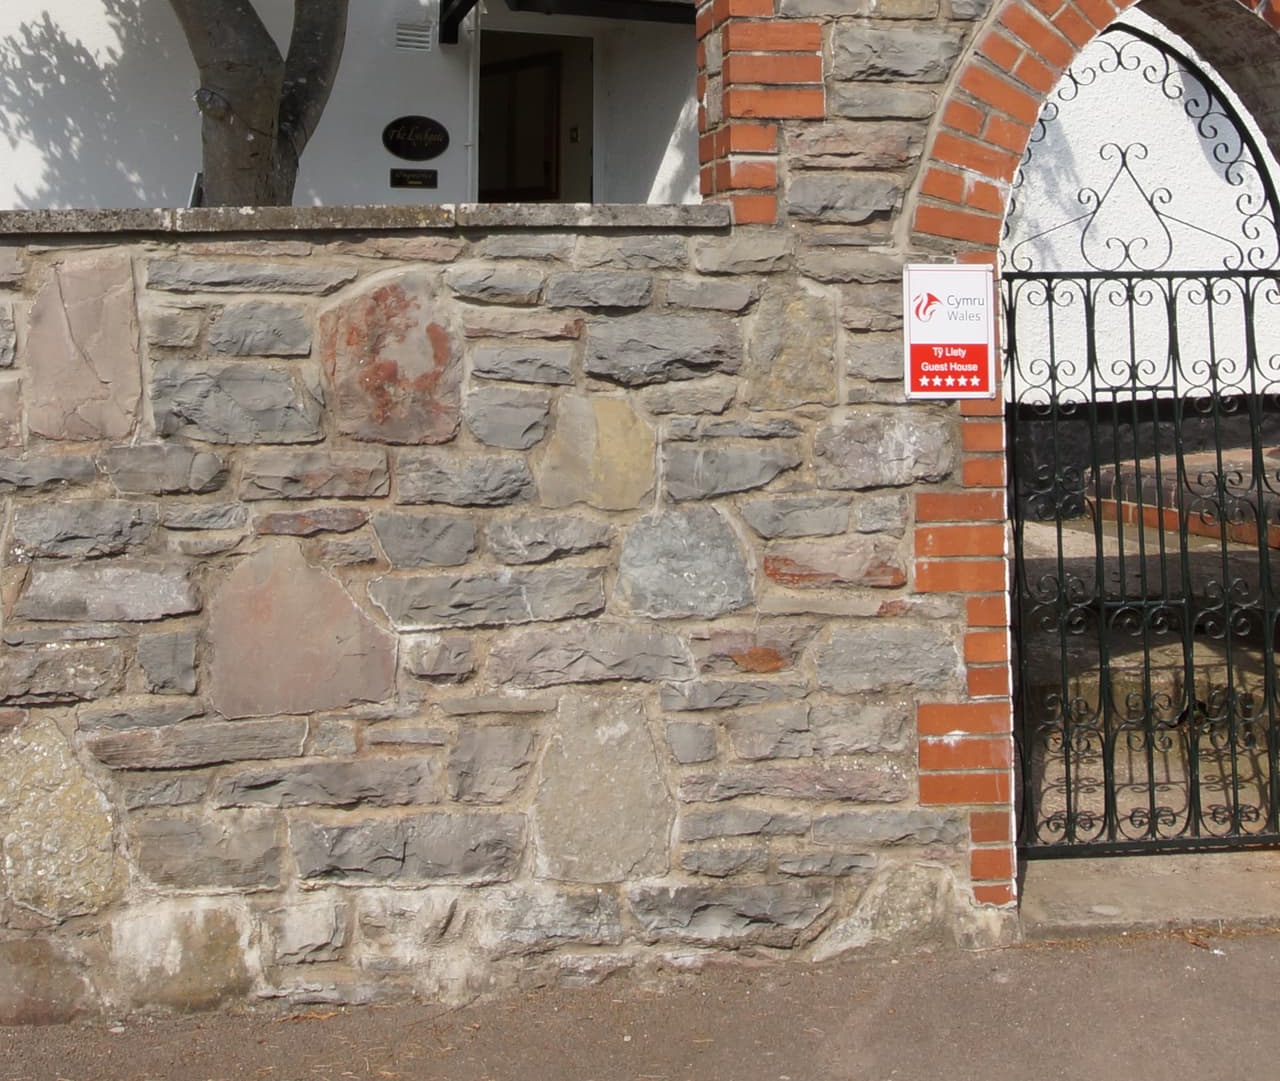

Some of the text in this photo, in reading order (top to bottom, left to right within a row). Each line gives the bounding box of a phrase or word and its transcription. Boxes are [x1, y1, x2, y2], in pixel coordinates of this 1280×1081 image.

[947, 294, 985, 309] Cymru
[947, 310, 981, 321] Wales
[921, 362, 979, 372] Guest House
